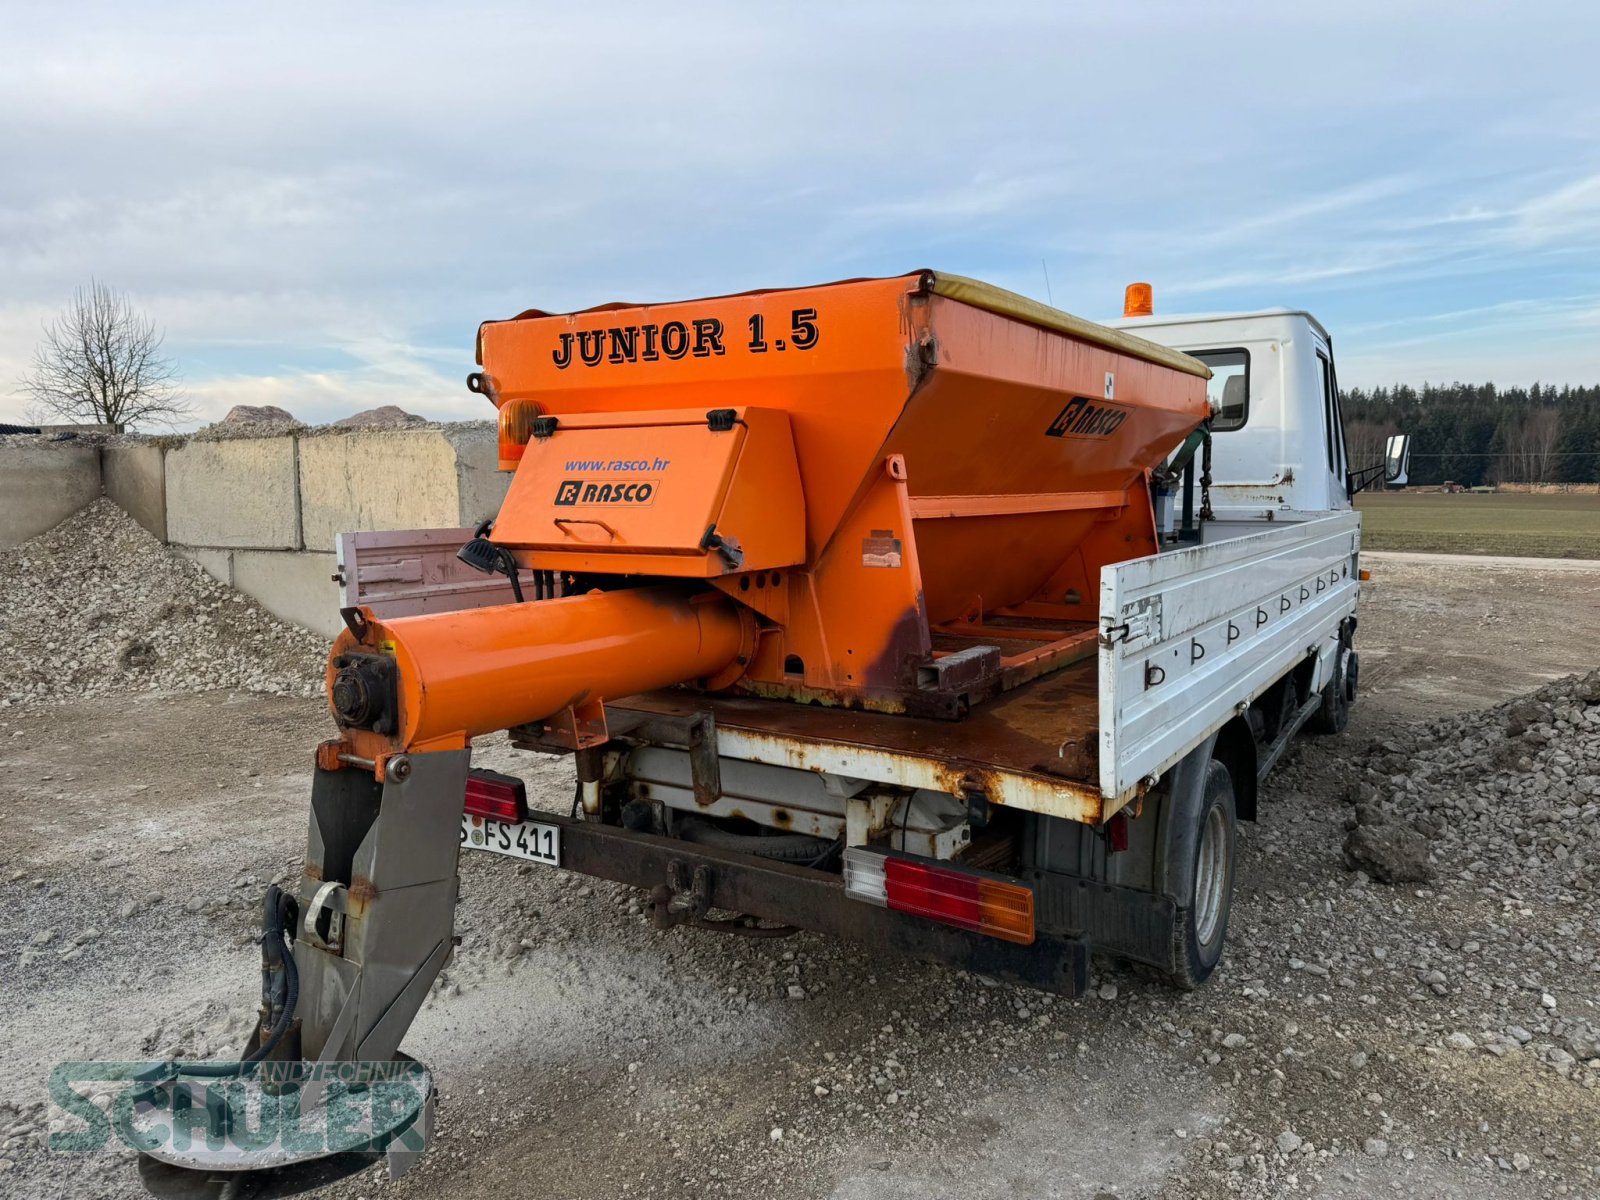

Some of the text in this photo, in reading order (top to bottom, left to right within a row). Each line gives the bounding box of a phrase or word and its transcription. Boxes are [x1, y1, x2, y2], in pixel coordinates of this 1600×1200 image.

[552, 308, 818, 369] JUNIOR 1.5
[1070, 405, 1127, 435] RASCO
[565, 457, 670, 472] www.rasco.hr
[581, 483, 653, 503] RASCO
[516, 825, 556, 861] 411
